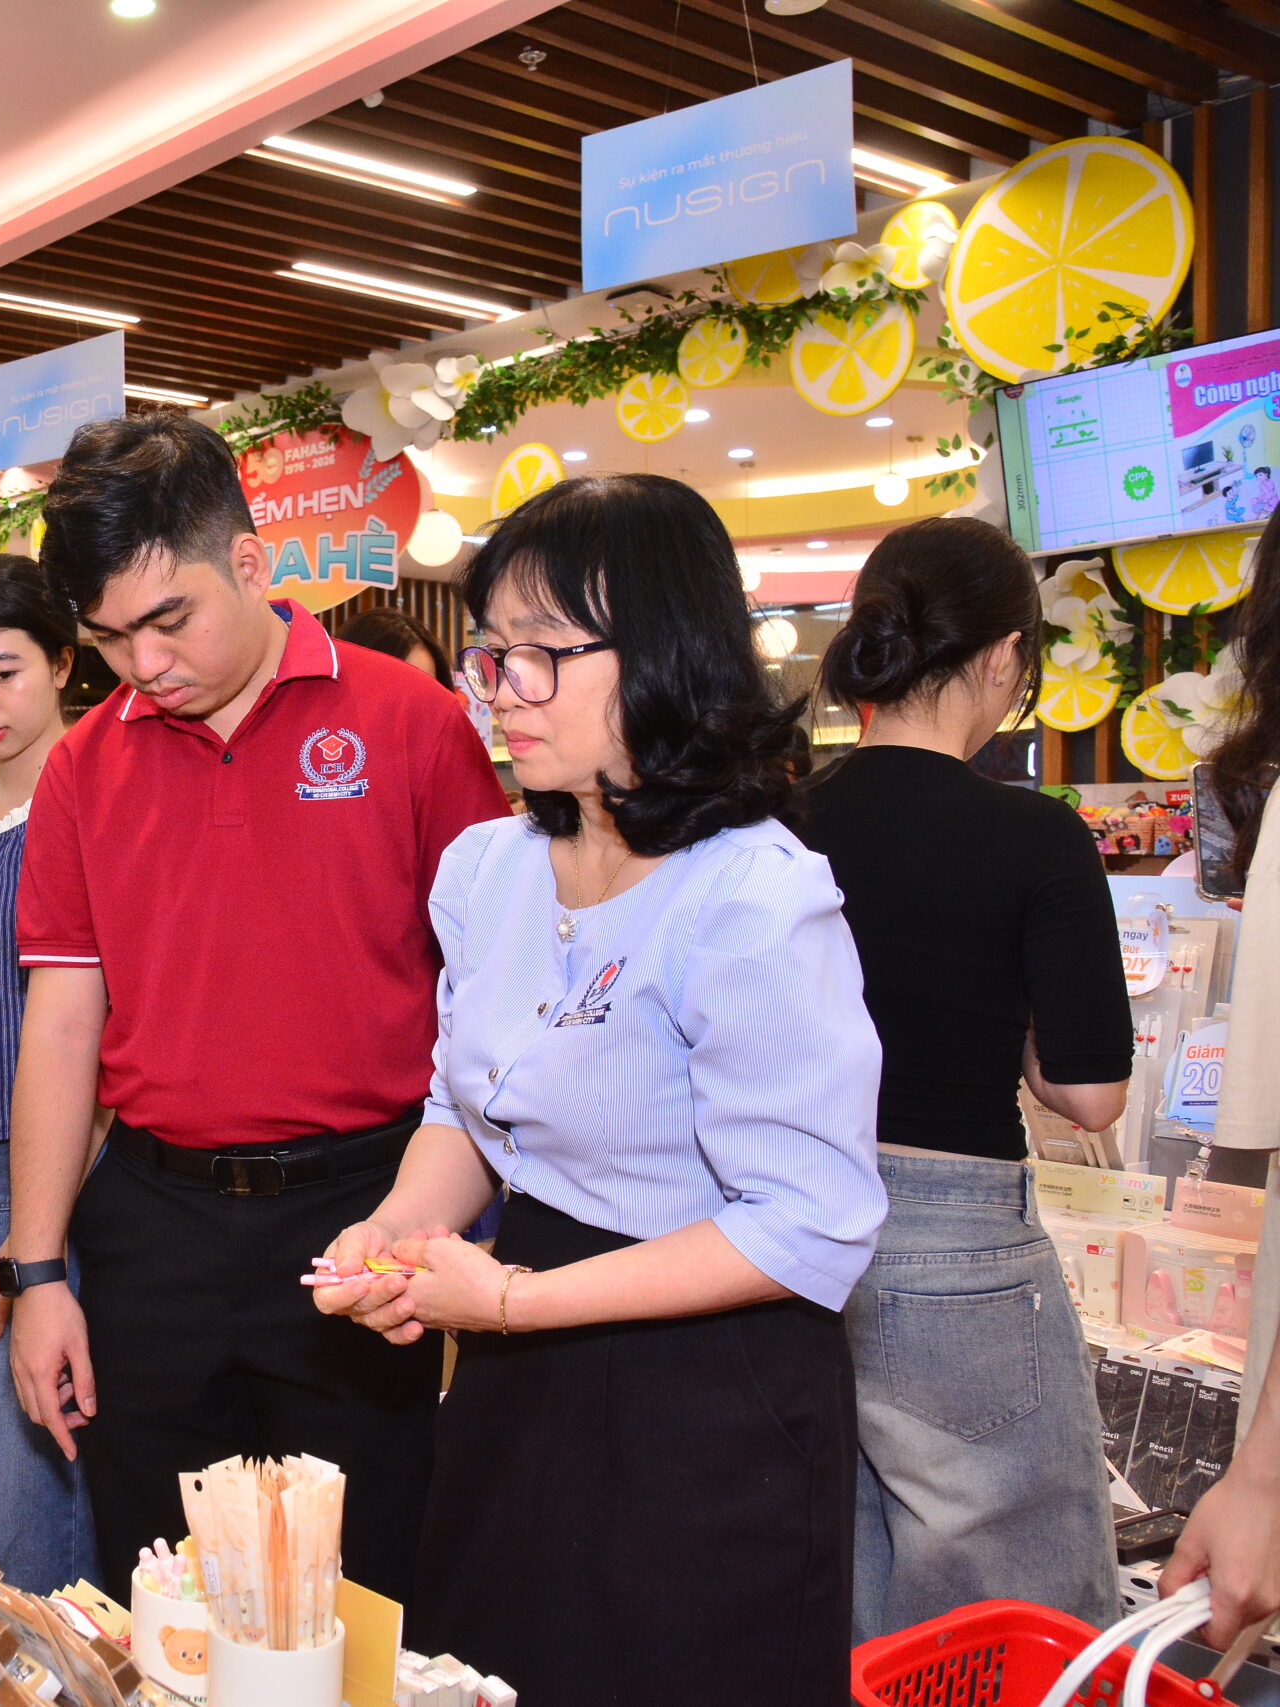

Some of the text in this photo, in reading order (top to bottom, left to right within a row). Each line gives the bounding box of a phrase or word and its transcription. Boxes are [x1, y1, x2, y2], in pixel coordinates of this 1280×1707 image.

[671, 164, 685, 176] ra
[1193, 369, 1280, 407] Công ngh
[1128, 471, 1148, 483] CPP
[249, 481, 365, 527] ỂM HẸN
[317, 514, 398, 590] HÈ
[320, 762, 345, 774] ICH
[1170, 793, 1190, 803] ZUR
[1186, 1044, 1226, 1059] Giảm
[1101, 1430, 1120, 1440] encil
[1149, 1441, 1174, 1454] Pencil
[1195, 1458, 1221, 1471] Pencil
